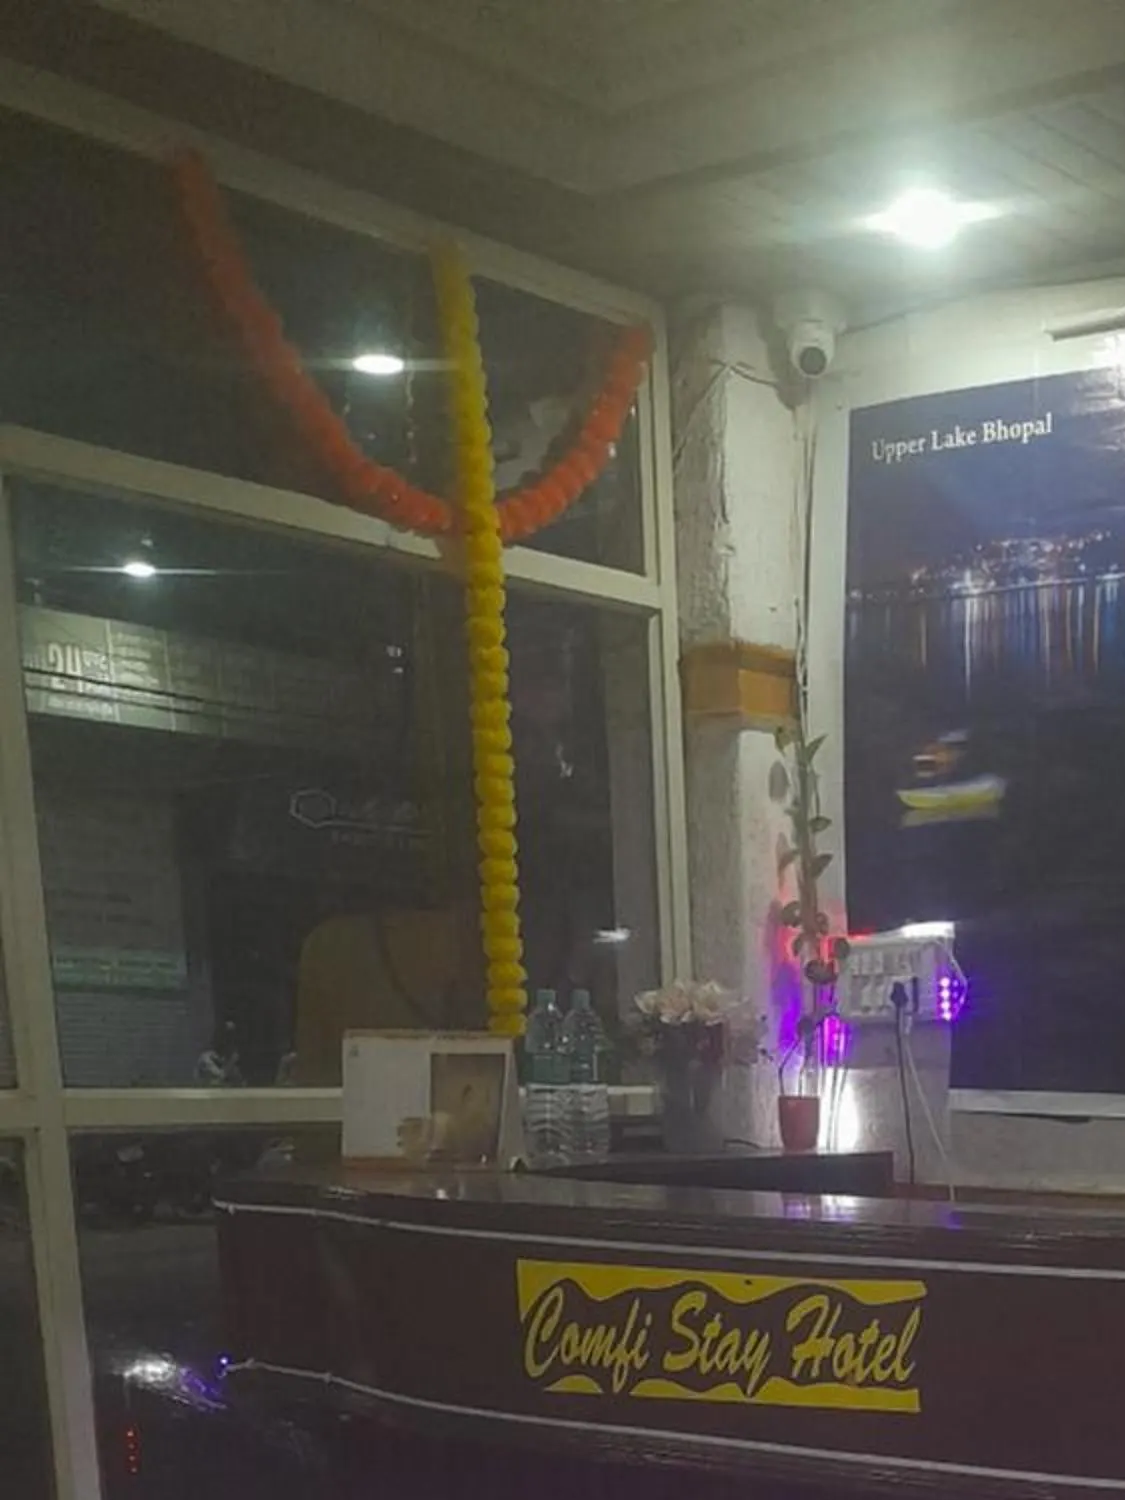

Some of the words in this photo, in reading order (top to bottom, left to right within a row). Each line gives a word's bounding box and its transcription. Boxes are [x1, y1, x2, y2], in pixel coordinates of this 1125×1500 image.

[871, 438, 926, 464] Upper
[931, 426, 977, 450] Lake
[982, 412, 1053, 443] Bhopal
[525, 1286, 652, 1393] Comfi
[663, 1291, 771, 1396] Stay
[786, 1294, 921, 1383] Hotel
